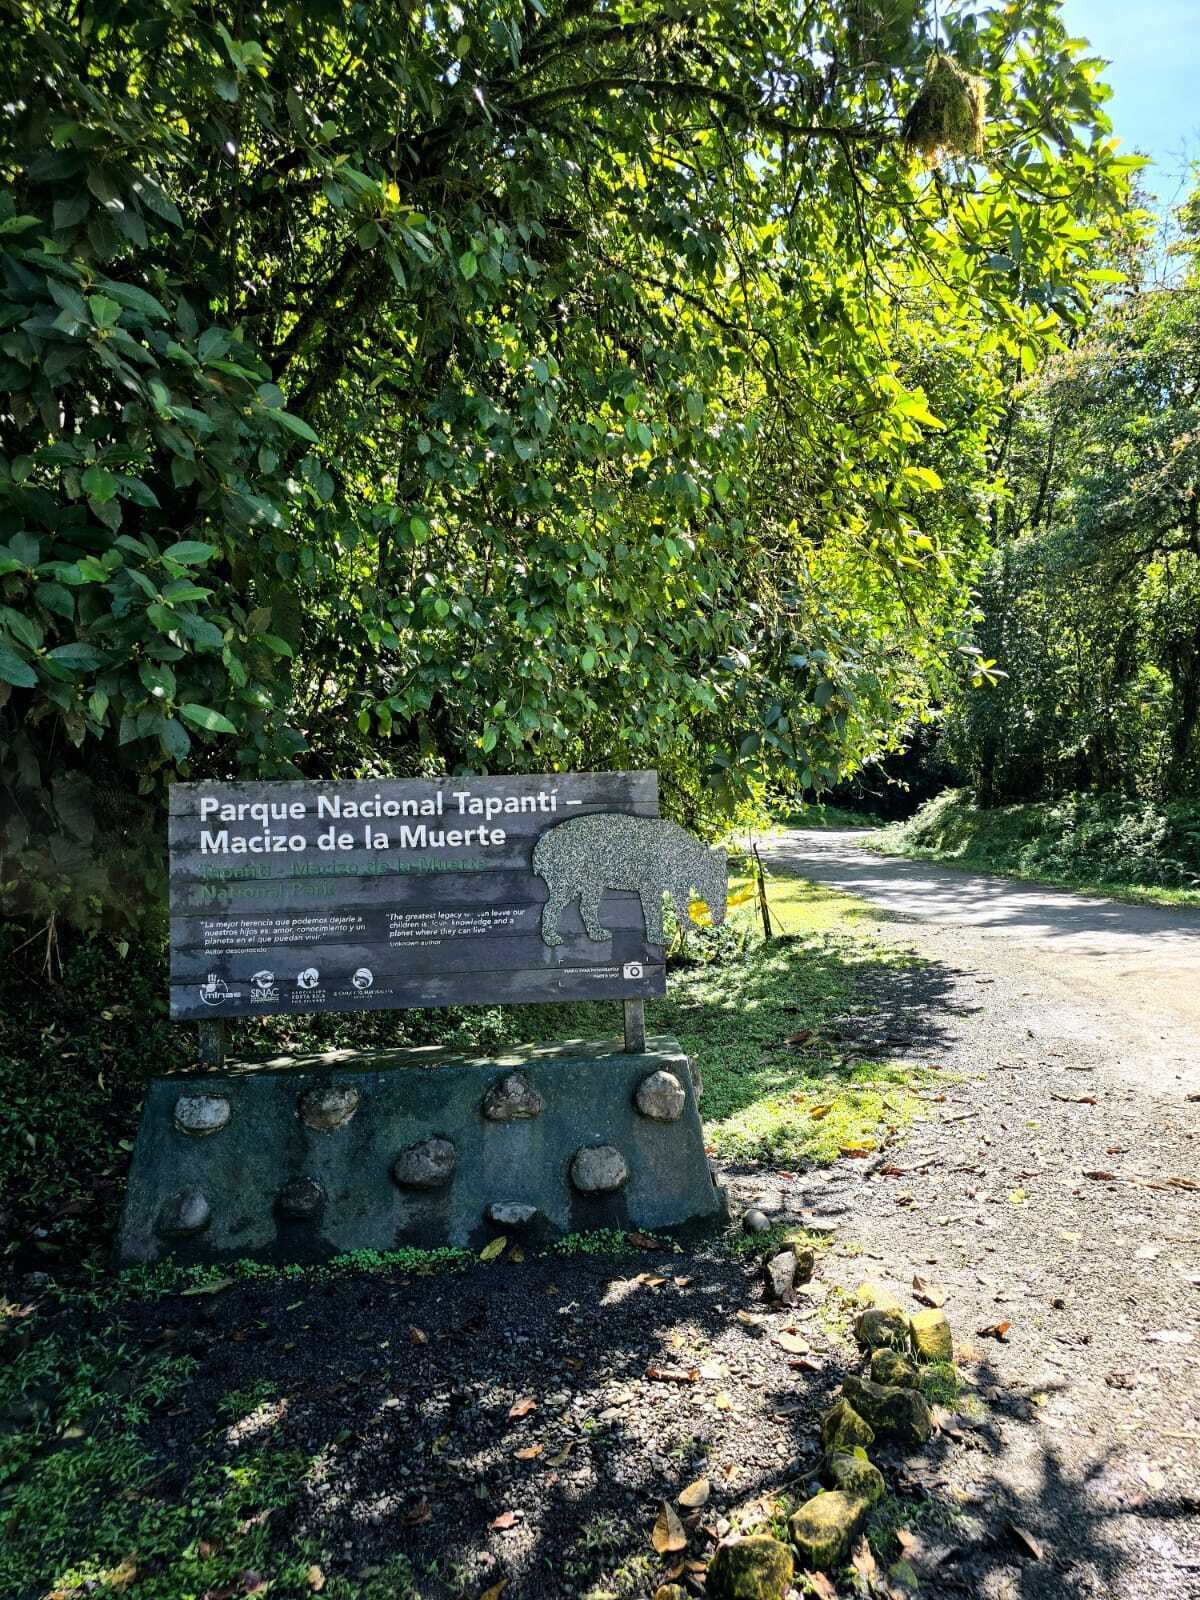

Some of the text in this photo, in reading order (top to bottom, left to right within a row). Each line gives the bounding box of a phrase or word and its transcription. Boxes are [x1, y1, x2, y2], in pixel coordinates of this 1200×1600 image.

[200, 796, 307, 827] Parque
[317, 791, 443, 819] Nacional
[452, 788, 558, 821] Tapantí
[200, 824, 507, 854] Macizo de la Muerte
[405, 913, 436, 922] greatest
[438, 911, 462, 920] legacy
[216, 921, 238, 930] mejor
[240, 919, 273, 928] herencia
[389, 920, 420, 929] children
[493, 916, 508, 925] and
[389, 929, 413, 938] planet
[415, 928, 438, 936] where
[204, 936, 234, 946] planeta
[250, 987, 280, 998] SINAC
